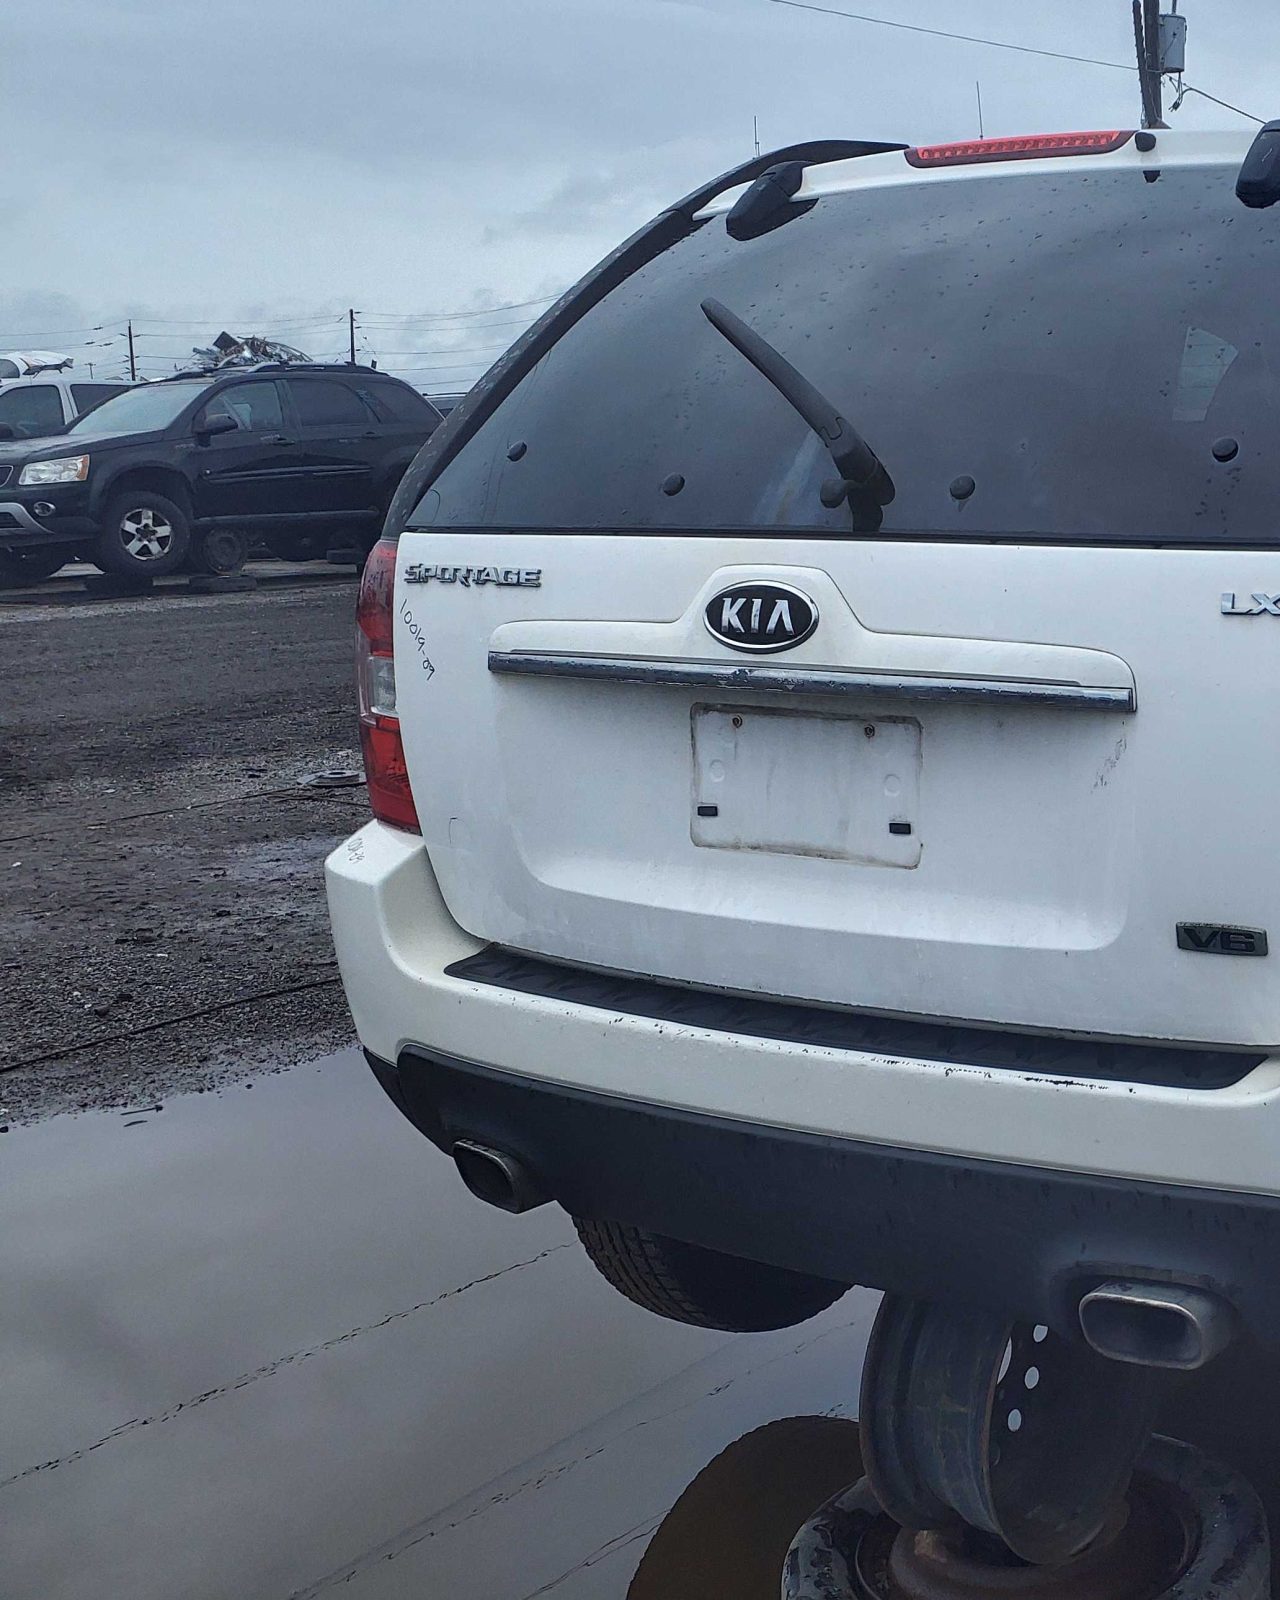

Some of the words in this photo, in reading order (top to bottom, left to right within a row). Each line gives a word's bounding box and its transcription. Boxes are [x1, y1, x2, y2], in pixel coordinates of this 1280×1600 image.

[404, 564, 542, 587] SPORTAGE
[721, 597, 795, 636] KIA
[1183, 928, 1255, 953] V6
